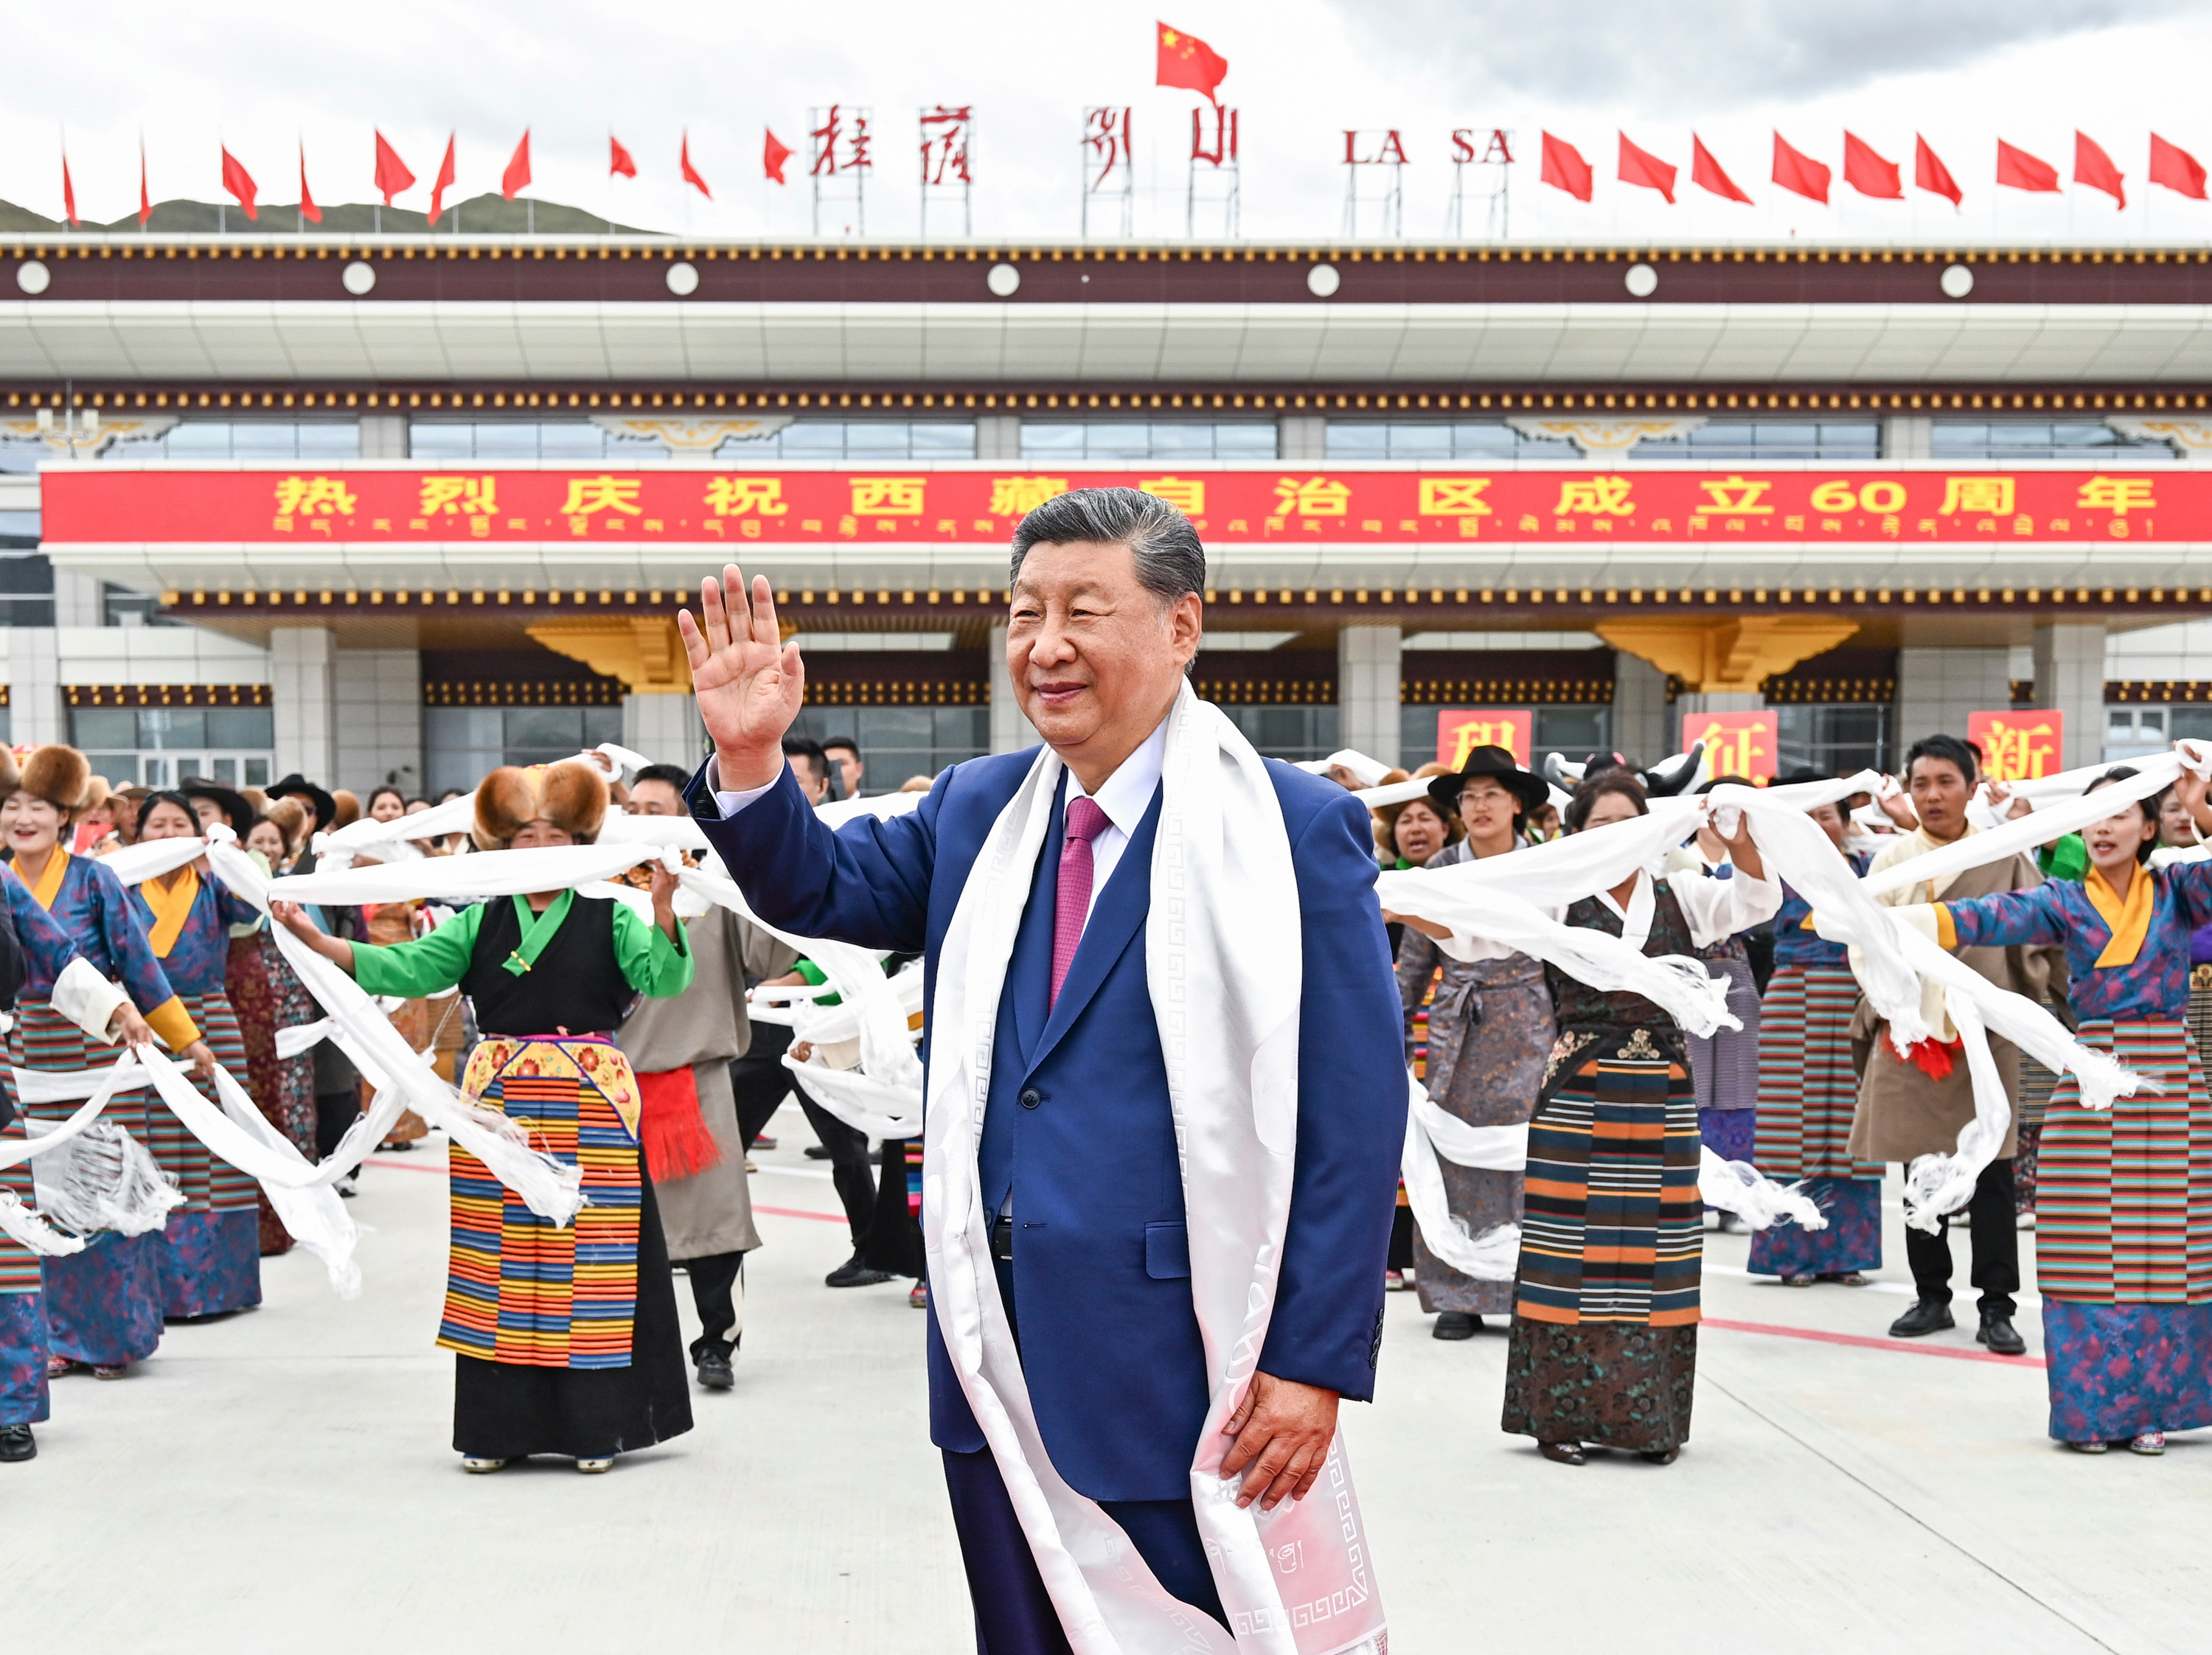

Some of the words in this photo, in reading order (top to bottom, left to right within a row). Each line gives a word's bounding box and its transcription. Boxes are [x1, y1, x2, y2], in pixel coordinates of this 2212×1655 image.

[1342, 129, 1410, 164] LA
[1451, 128, 1515, 164] SA
[274, 475, 2157, 516] 热烈庆祝西藏自治区成立60周年
[1698, 722, 1770, 787] 征
[1980, 720, 2053, 782] 新
